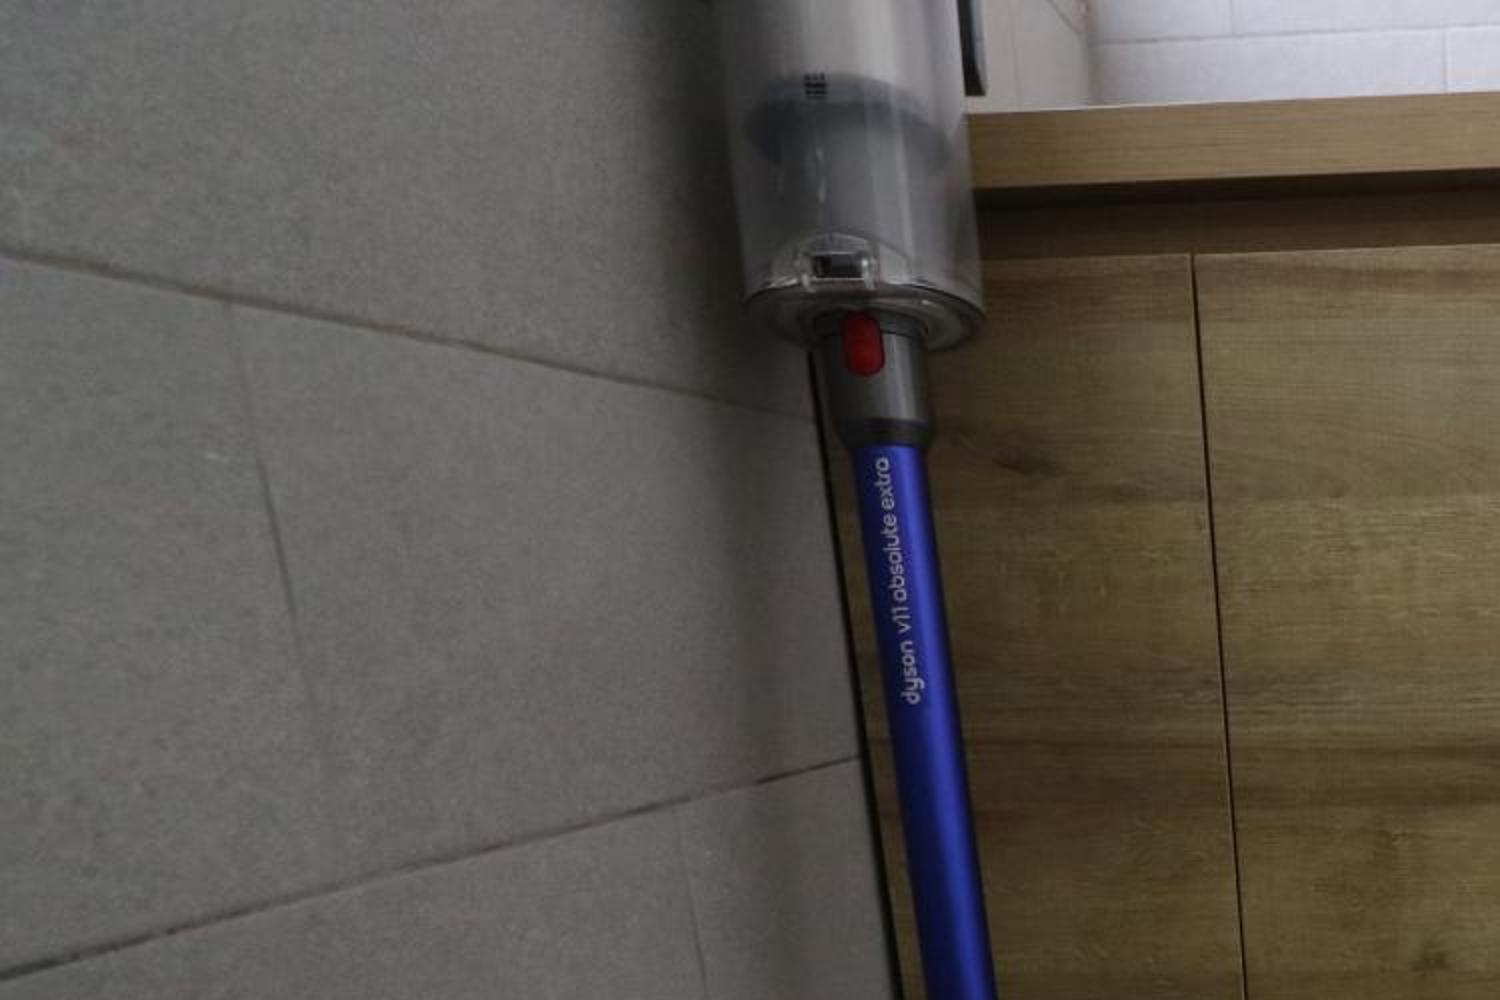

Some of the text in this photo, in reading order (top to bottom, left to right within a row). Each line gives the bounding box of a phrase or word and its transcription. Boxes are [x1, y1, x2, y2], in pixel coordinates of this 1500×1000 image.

[874, 456, 925, 705] dyson v11 absolute extra
